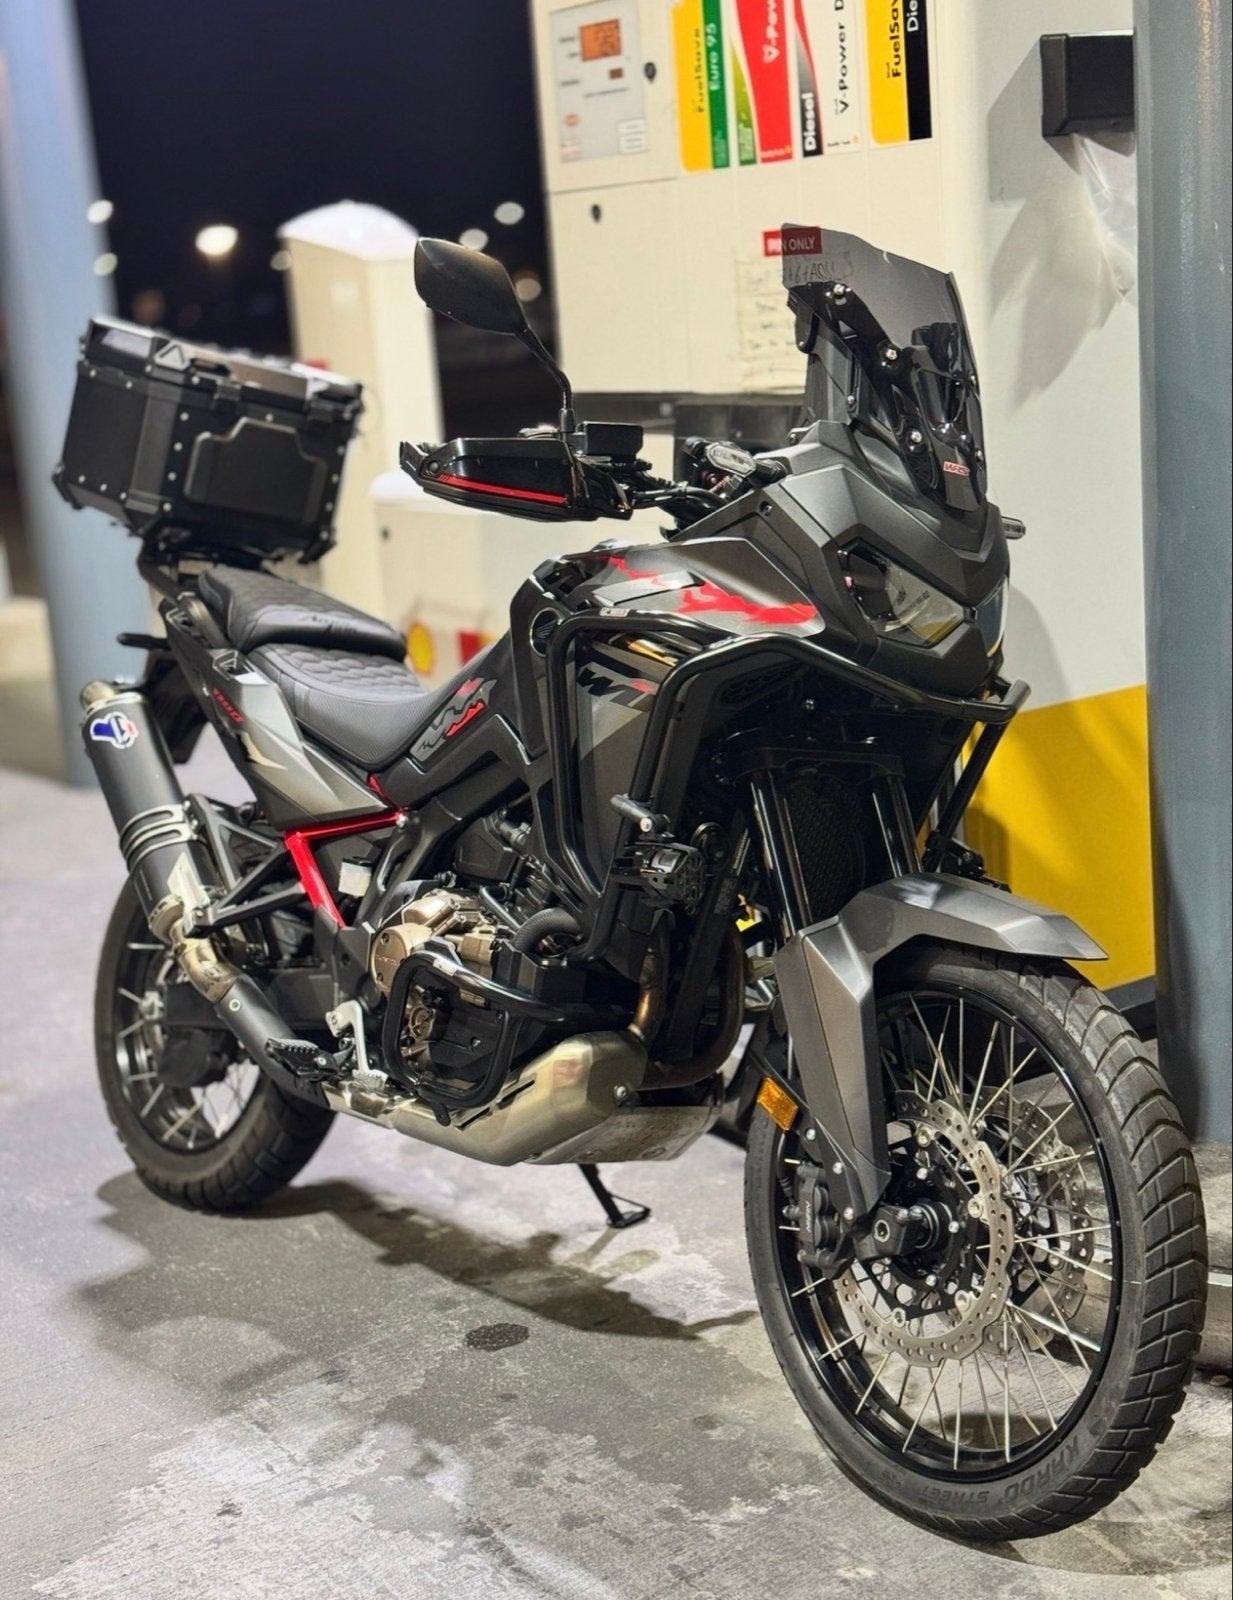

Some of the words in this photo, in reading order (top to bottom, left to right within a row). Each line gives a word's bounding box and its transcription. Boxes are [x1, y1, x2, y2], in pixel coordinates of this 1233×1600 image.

[706, 22, 718, 48] 95
[709, 51, 721, 91] Euro
[838, 22, 850, 114] V-Power
[801, 92, 817, 151] Diesel
[788, 236, 816, 251] ONLY
